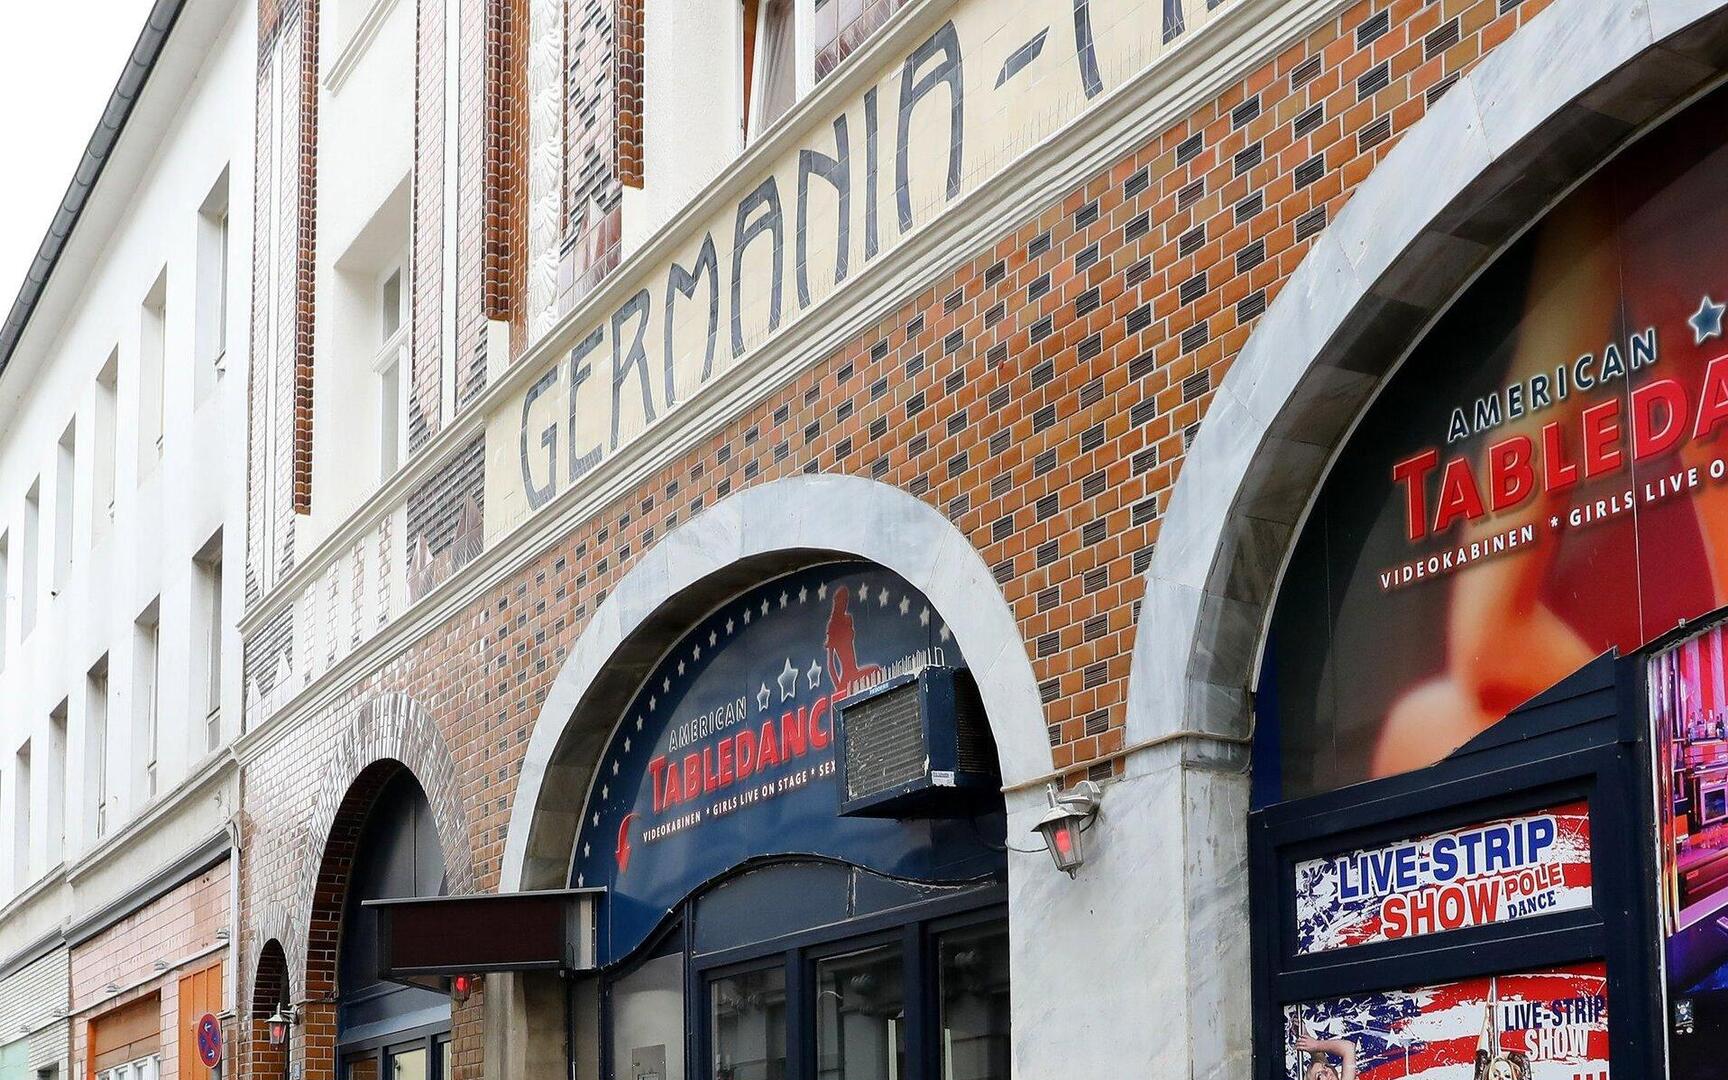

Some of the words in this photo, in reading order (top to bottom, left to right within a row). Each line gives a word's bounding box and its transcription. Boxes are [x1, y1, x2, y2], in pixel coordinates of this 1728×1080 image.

[1447, 327, 1657, 443] AMERICAN
[1379, 524, 1534, 590] VIDEOKABINEN
[1569, 490, 1634, 527] GIRLS
[1645, 467, 1699, 502] LIVE
[669, 696, 747, 752] AMERICAN
[642, 809, 701, 843] VIDEOKABINEN
[713, 798, 738, 816] GIRLS
[740, 789, 759, 806] LIVE
[762, 782, 775, 798] ON
[778, 770, 807, 792] STAGE
[1339, 817, 1556, 899] LIVE-STRIP
[1505, 862, 1564, 901] POLE
[1382, 879, 1499, 940] SHOW
[1507, 890, 1557, 920] DANCE
[1504, 993, 1605, 1031] LIVE-STRIP
[1524, 1025, 1589, 1061] SHOW
